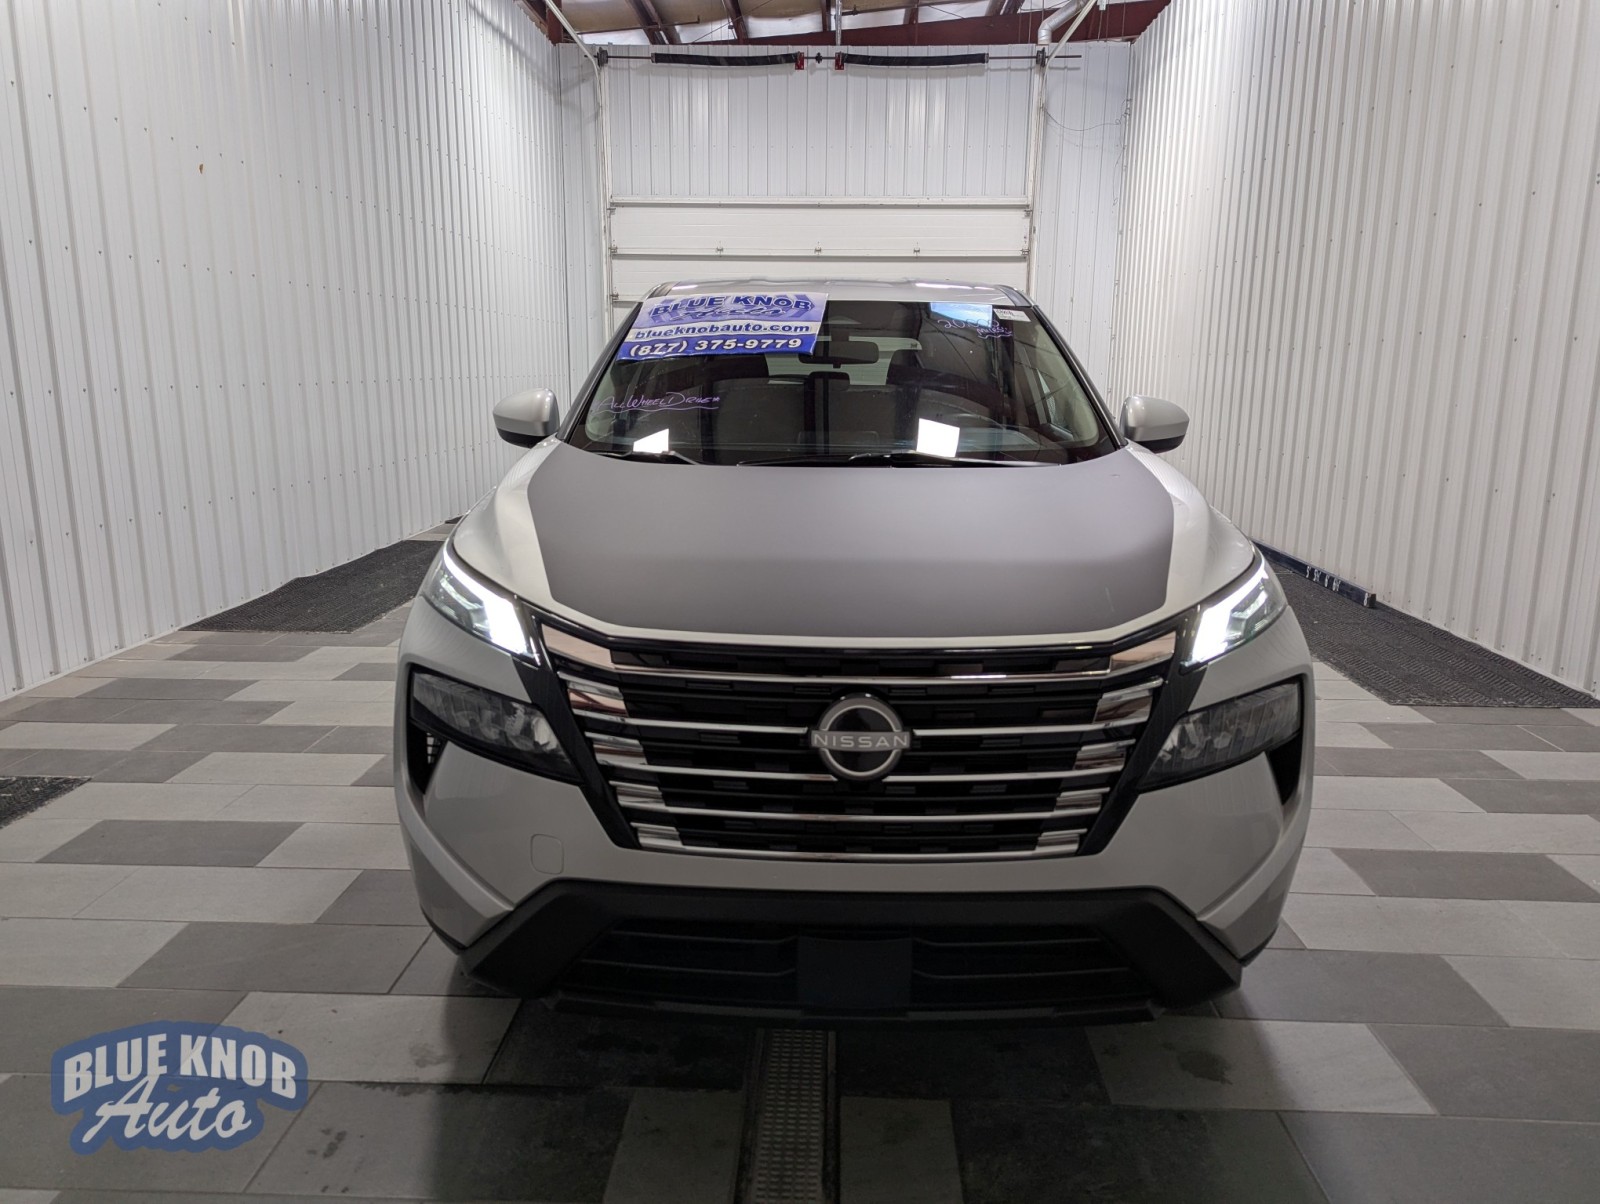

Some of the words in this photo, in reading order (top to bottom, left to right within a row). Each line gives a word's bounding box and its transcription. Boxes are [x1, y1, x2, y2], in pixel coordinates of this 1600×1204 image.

[650, 296, 725, 317] BLUE
[733, 295, 813, 311] KNOB
[634, 322, 810, 340] blueknobauto.com
[629, 340, 688, 358] (877)
[695, 338, 802, 351] 375-9779
[813, 733, 908, 748] NISSAN
